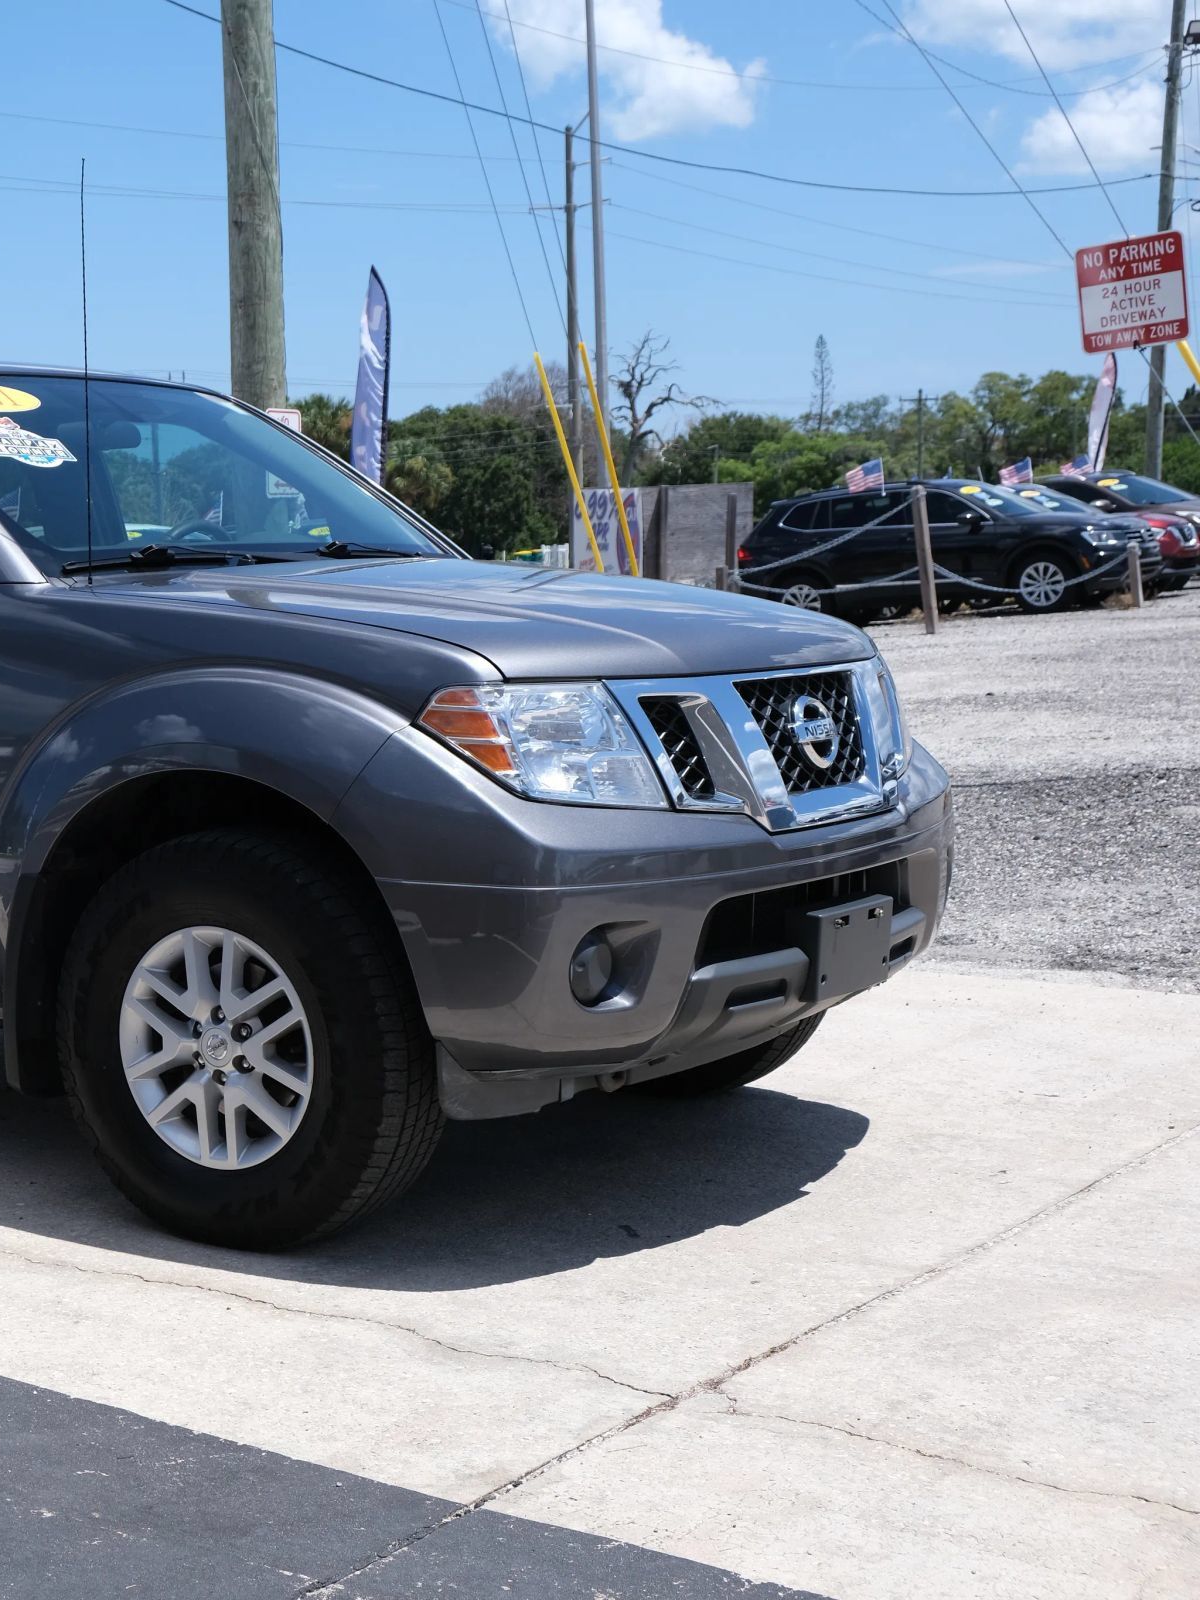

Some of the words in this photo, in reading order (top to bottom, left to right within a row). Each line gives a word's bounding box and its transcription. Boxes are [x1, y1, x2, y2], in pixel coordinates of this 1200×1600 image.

[1083, 252, 1103, 269] NO
[1109, 238, 1175, 264] PARKING
[1099, 265, 1126, 281] ANY
[1131, 259, 1162, 275] TIME
[1101, 286, 1118, 299] 24
[1124, 278, 1161, 296] HOUR
[1110, 294, 1156, 312] ACTIVE
[1100, 307, 1166, 328] DRIVEWAY
[1090, 333, 1112, 348] TOW
[1116, 329, 1145, 344] AWAY
[1150, 322, 1181, 339] ZONE
[804, 723, 836, 737] NISSA
